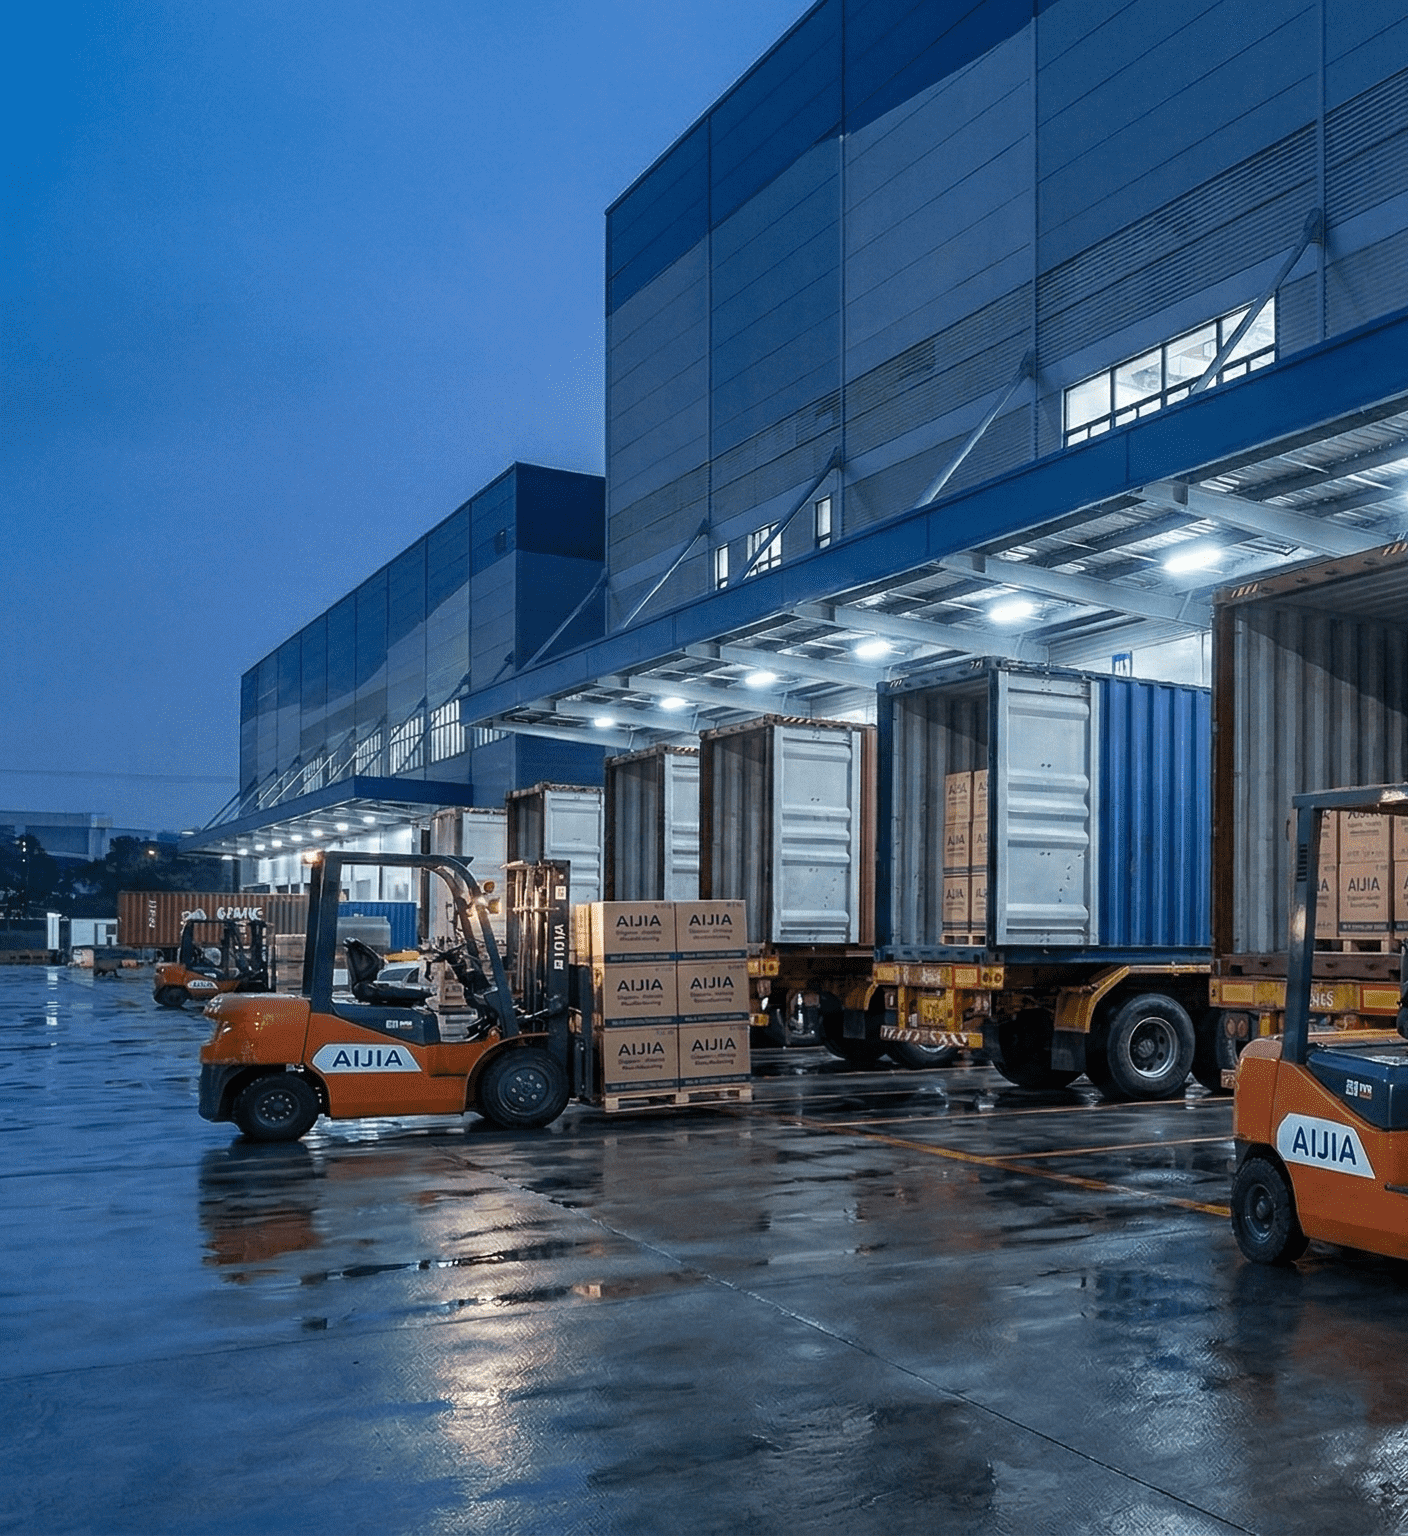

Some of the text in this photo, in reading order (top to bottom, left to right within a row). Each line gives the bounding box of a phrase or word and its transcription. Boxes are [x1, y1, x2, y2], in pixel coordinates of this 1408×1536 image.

[1348, 877, 1380, 892] AIJIA
[616, 915, 662, 927] AIJIA
[689, 914, 733, 927] AIJIA
[617, 979, 663, 992] AIJIA
[690, 976, 734, 990] AIJIA
[618, 1042, 665, 1056] AIJIA
[691, 1037, 737, 1052] AIJIA
[332, 1050, 403, 1067] AIJIA
[1292, 1126, 1357, 1166] AIJIA
